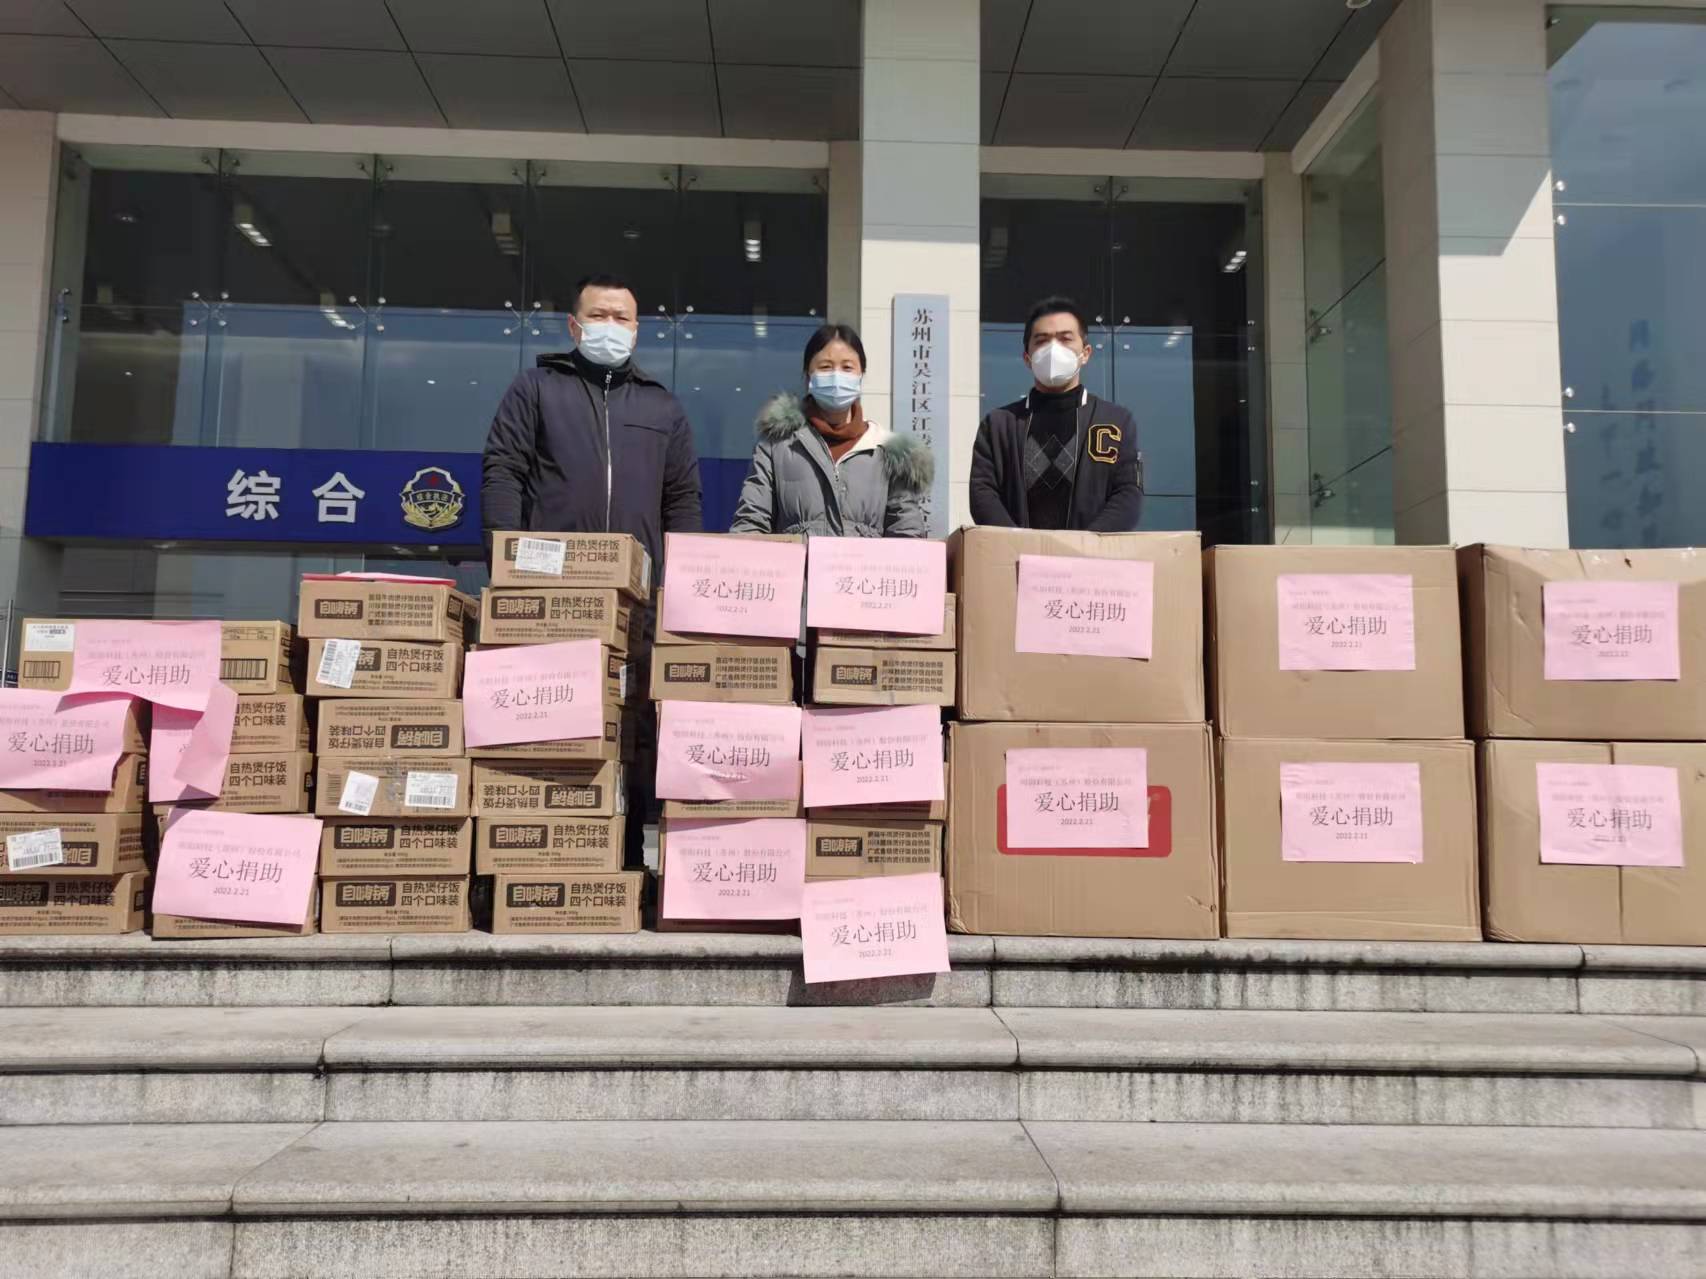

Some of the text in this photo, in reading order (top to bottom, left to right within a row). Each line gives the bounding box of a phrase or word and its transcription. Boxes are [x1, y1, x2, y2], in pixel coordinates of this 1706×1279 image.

[1088, 423, 1122, 464] C
[225, 469, 366, 523] 综合
[566, 539, 620, 551] 自热煲仔饭
[565, 551, 620, 563] 四个口味装
[692, 578, 775, 602] 爱心捐助
[835, 576, 918, 598] 爱心捐助
[320, 602, 359, 614] 自嗨锅
[497, 598, 540, 614] 自嗨锅
[551, 597, 605, 608] 自热煲仔饭
[550, 609, 605, 620] 四个口味装
[1044, 599, 1127, 622] 爱心捐助
[1304, 615, 1387, 636] 爱心捐助
[1571, 624, 1653, 645] 爱心捐助
[387, 648, 444, 661] 自热煲仔饭
[385, 661, 444, 673] 四个口味装
[669, 664, 708, 678] 自嗨锅
[836, 666, 873, 681] 自嗨锅
[102, 663, 191, 686] 爱心捐助
[490, 684, 574, 710] 爱心捐助
[329, 725, 386, 736] 四个口味装
[8, 731, 94, 754] 爱心捐助
[328, 737, 385, 749] 自热煲仔饭
[685, 744, 770, 767] 爱心捐助
[830, 747, 914, 771] 爱心捐助
[230, 761, 287, 774] 自热煲仔饭
[229, 774, 287, 787] 四个口味装
[483, 783, 541, 796] 四个口味装
[483, 796, 540, 809] 自热煲仔饭
[1034, 792, 1119, 813] 爱心捐助
[1309, 805, 1393, 826] 爱心捐助
[1567, 807, 1653, 830] 爱心捐助
[339, 825, 390, 843] 自嗨锅
[400, 824, 459, 837] 自热煲仔饭
[494, 825, 544, 844] 自嗨锅
[554, 824, 609, 837] 自热煲仔饭
[399, 837, 458, 850] 四个口味装
[553, 837, 609, 849] 四个口味装
[820, 839, 857, 852] 自嗨锅
[188, 856, 284, 884] 爱心捐助
[693, 861, 777, 883] 爱心捐助
[55, 881, 114, 894] 自热煲仔饭
[342, 885, 390, 902] 自嗨锅
[402, 882, 460, 894] 自热煲仔饭
[511, 883, 561, 902] 自嗨锅
[571, 882, 627, 894] 自热煲仔饭
[401, 895, 459, 907] 四个口味装
[570, 895, 627, 907] 四个口味装
[831, 919, 917, 945] 爱心捐助
